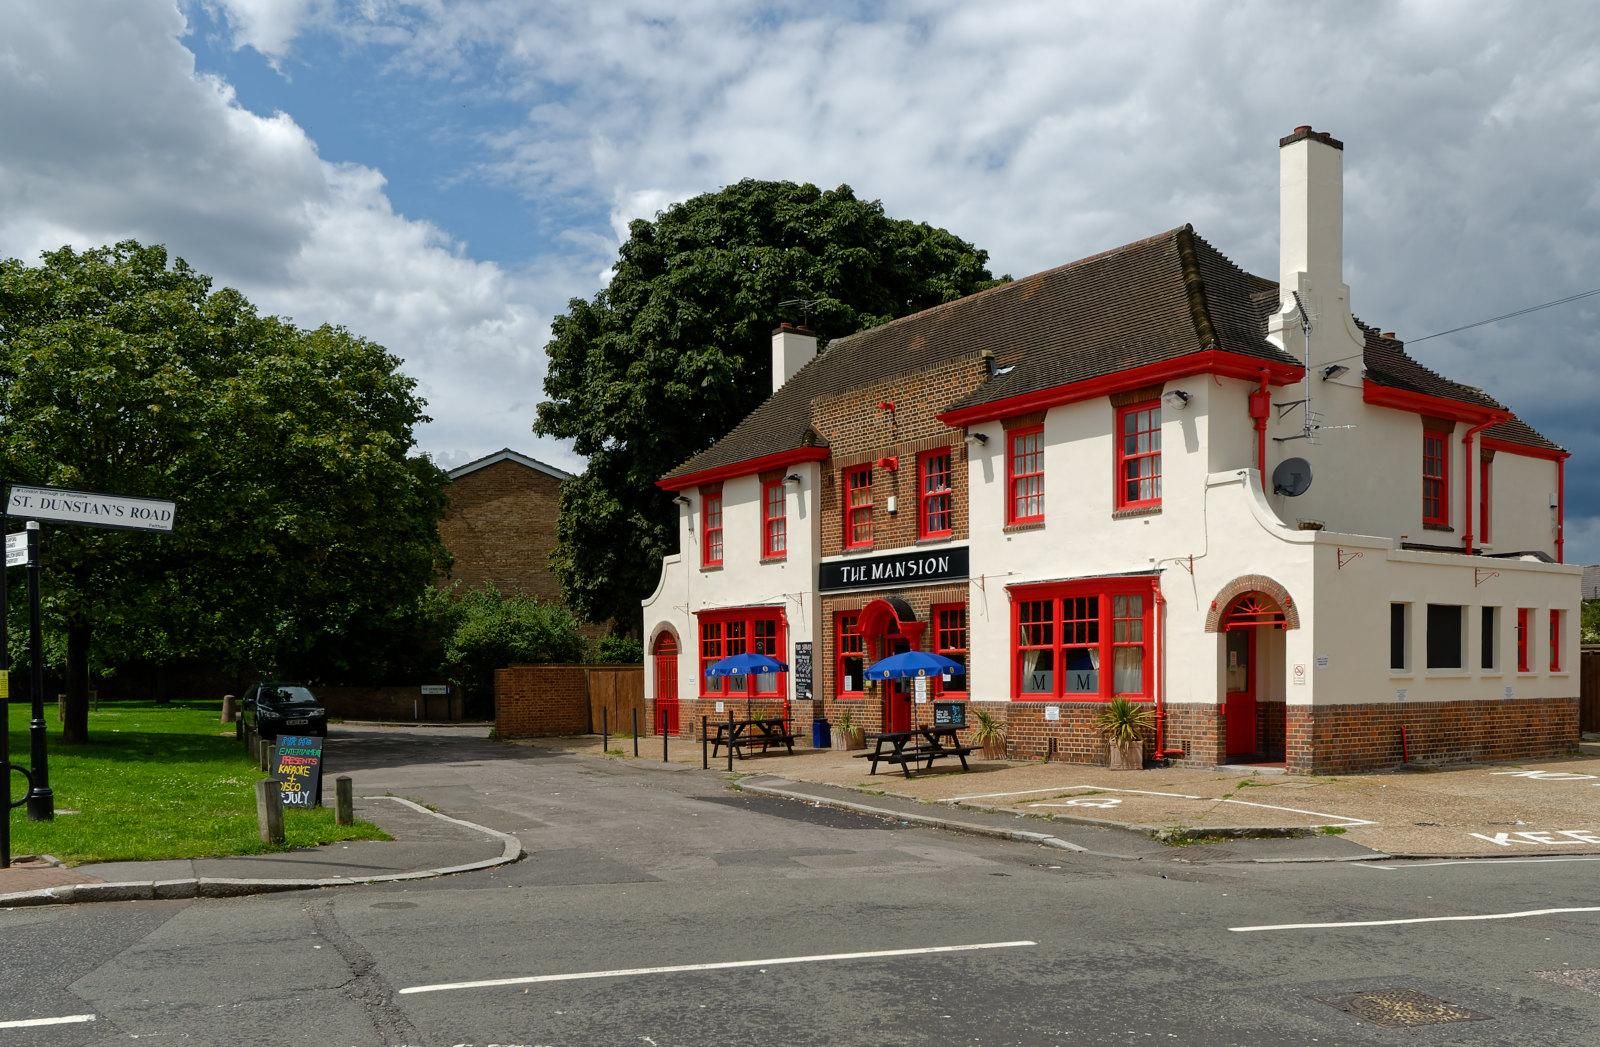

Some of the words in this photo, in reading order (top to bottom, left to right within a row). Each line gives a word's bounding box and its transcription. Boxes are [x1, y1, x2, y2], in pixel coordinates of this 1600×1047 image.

[12, 495, 33, 508] ST.
[40, 497, 125, 517] DUNSTAN'S
[130, 507, 171, 522] ROAD
[841, 565, 868, 582] THE
[871, 556, 949, 580] MANSION
[1032, 674, 1045, 690] M
[1077, 674, 1090, 690] M
[281, 756, 318, 765] PRESENTS
[278, 765, 310, 777] KARAOKE
[283, 790, 310, 804] JULY
